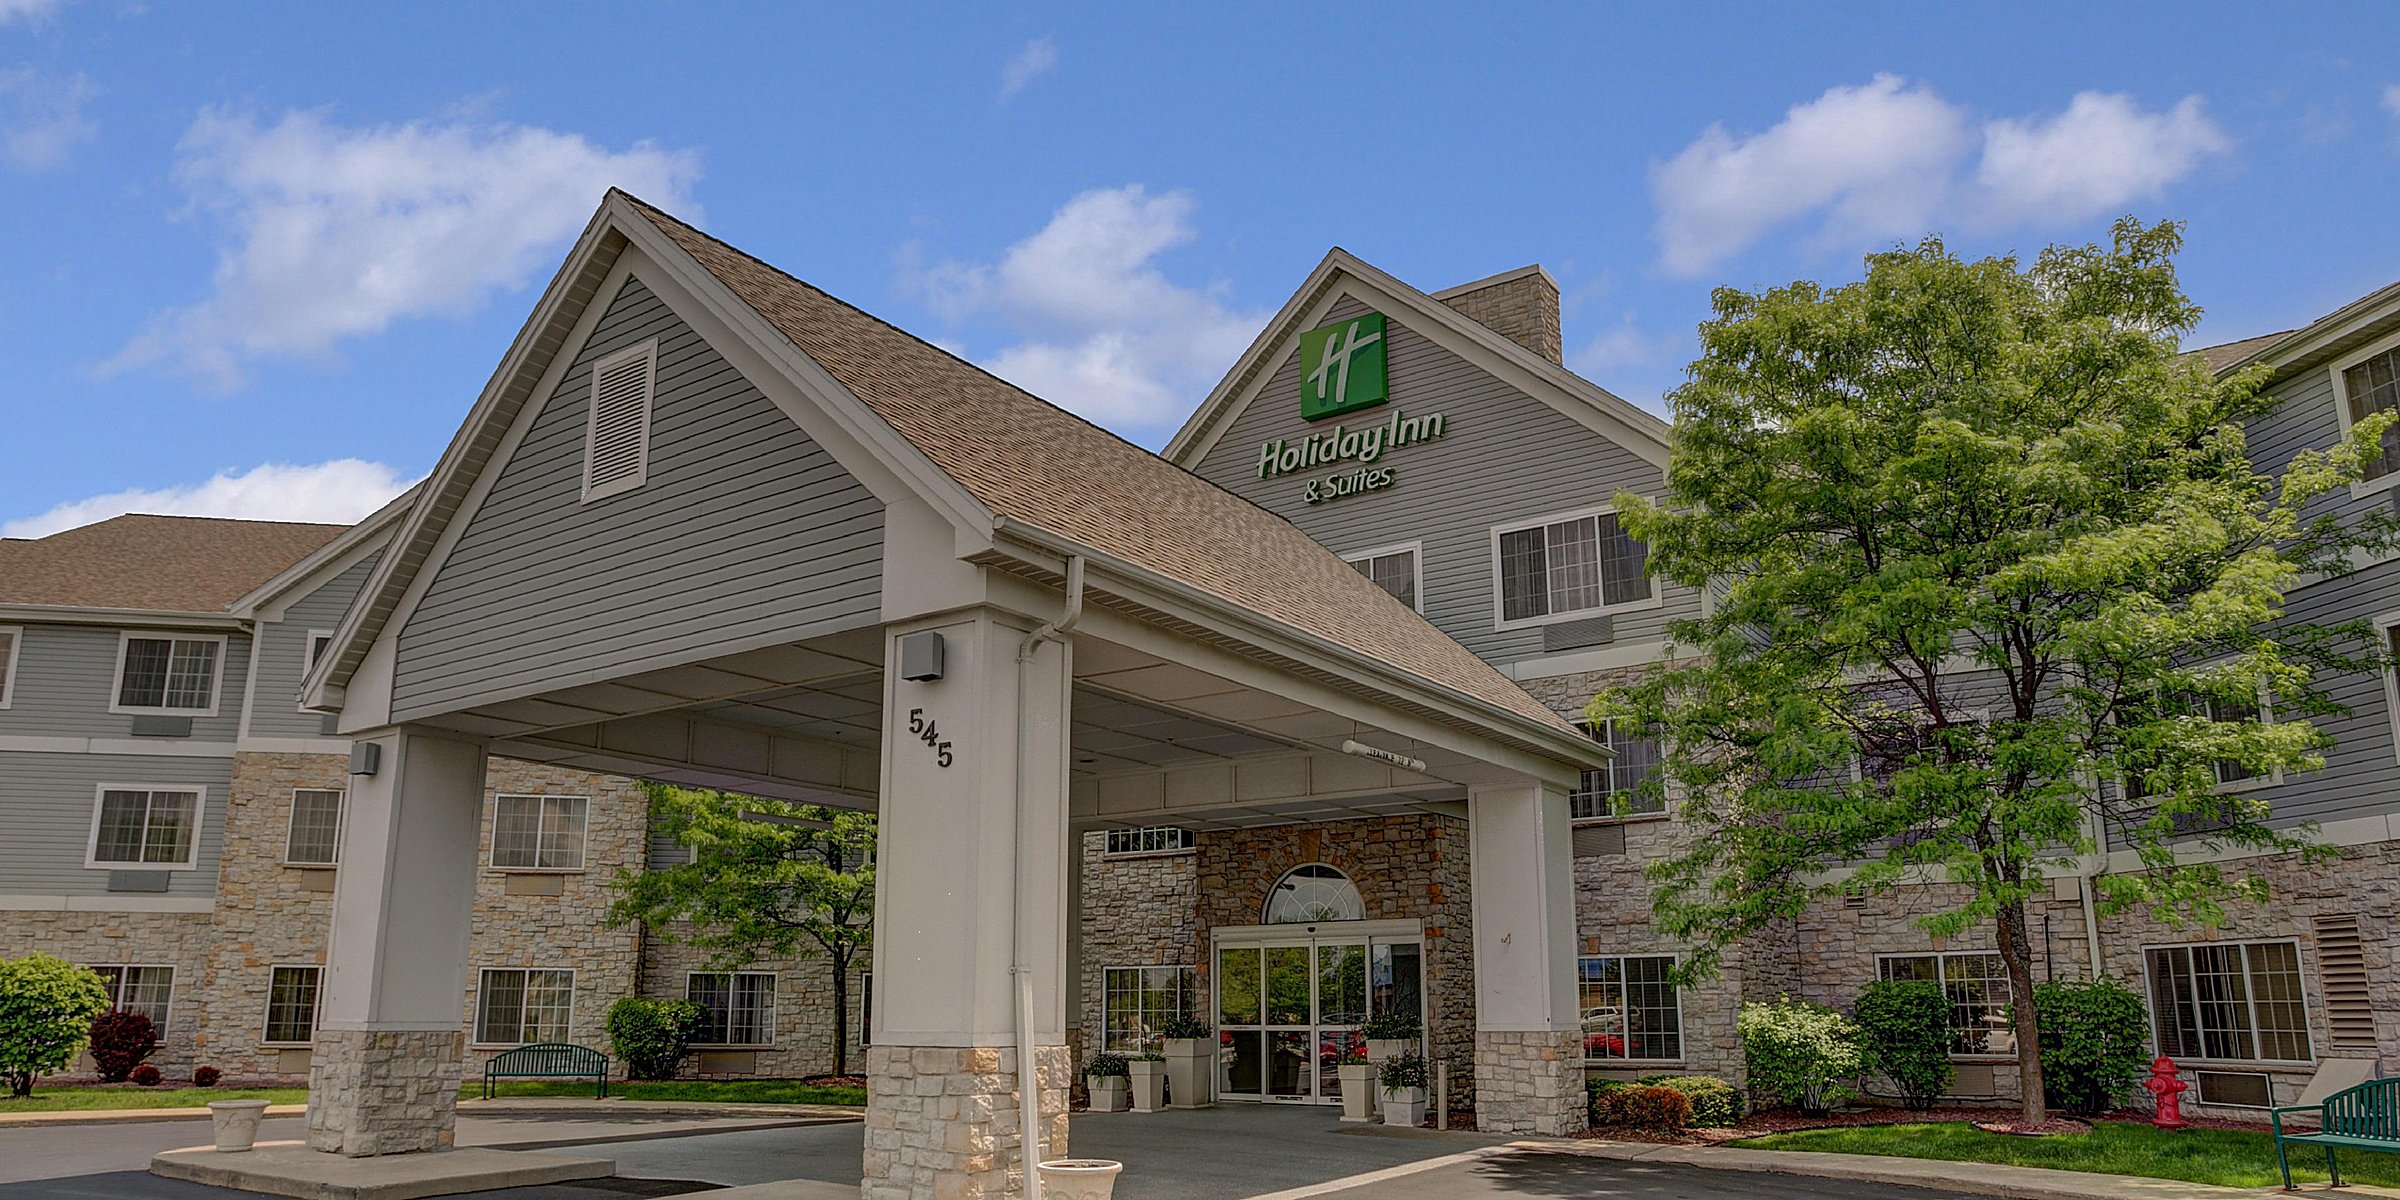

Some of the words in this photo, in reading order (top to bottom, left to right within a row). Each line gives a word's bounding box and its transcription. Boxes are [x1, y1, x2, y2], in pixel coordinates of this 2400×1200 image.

[1308, 321, 1381, 403] H
[1256, 425, 1385, 479] Holiday
[1388, 410, 1445, 447] Inn
[1304, 479, 1321, 503] &
[1323, 467, 1394, 499] Suites
[909, 708, 953, 768] 545
